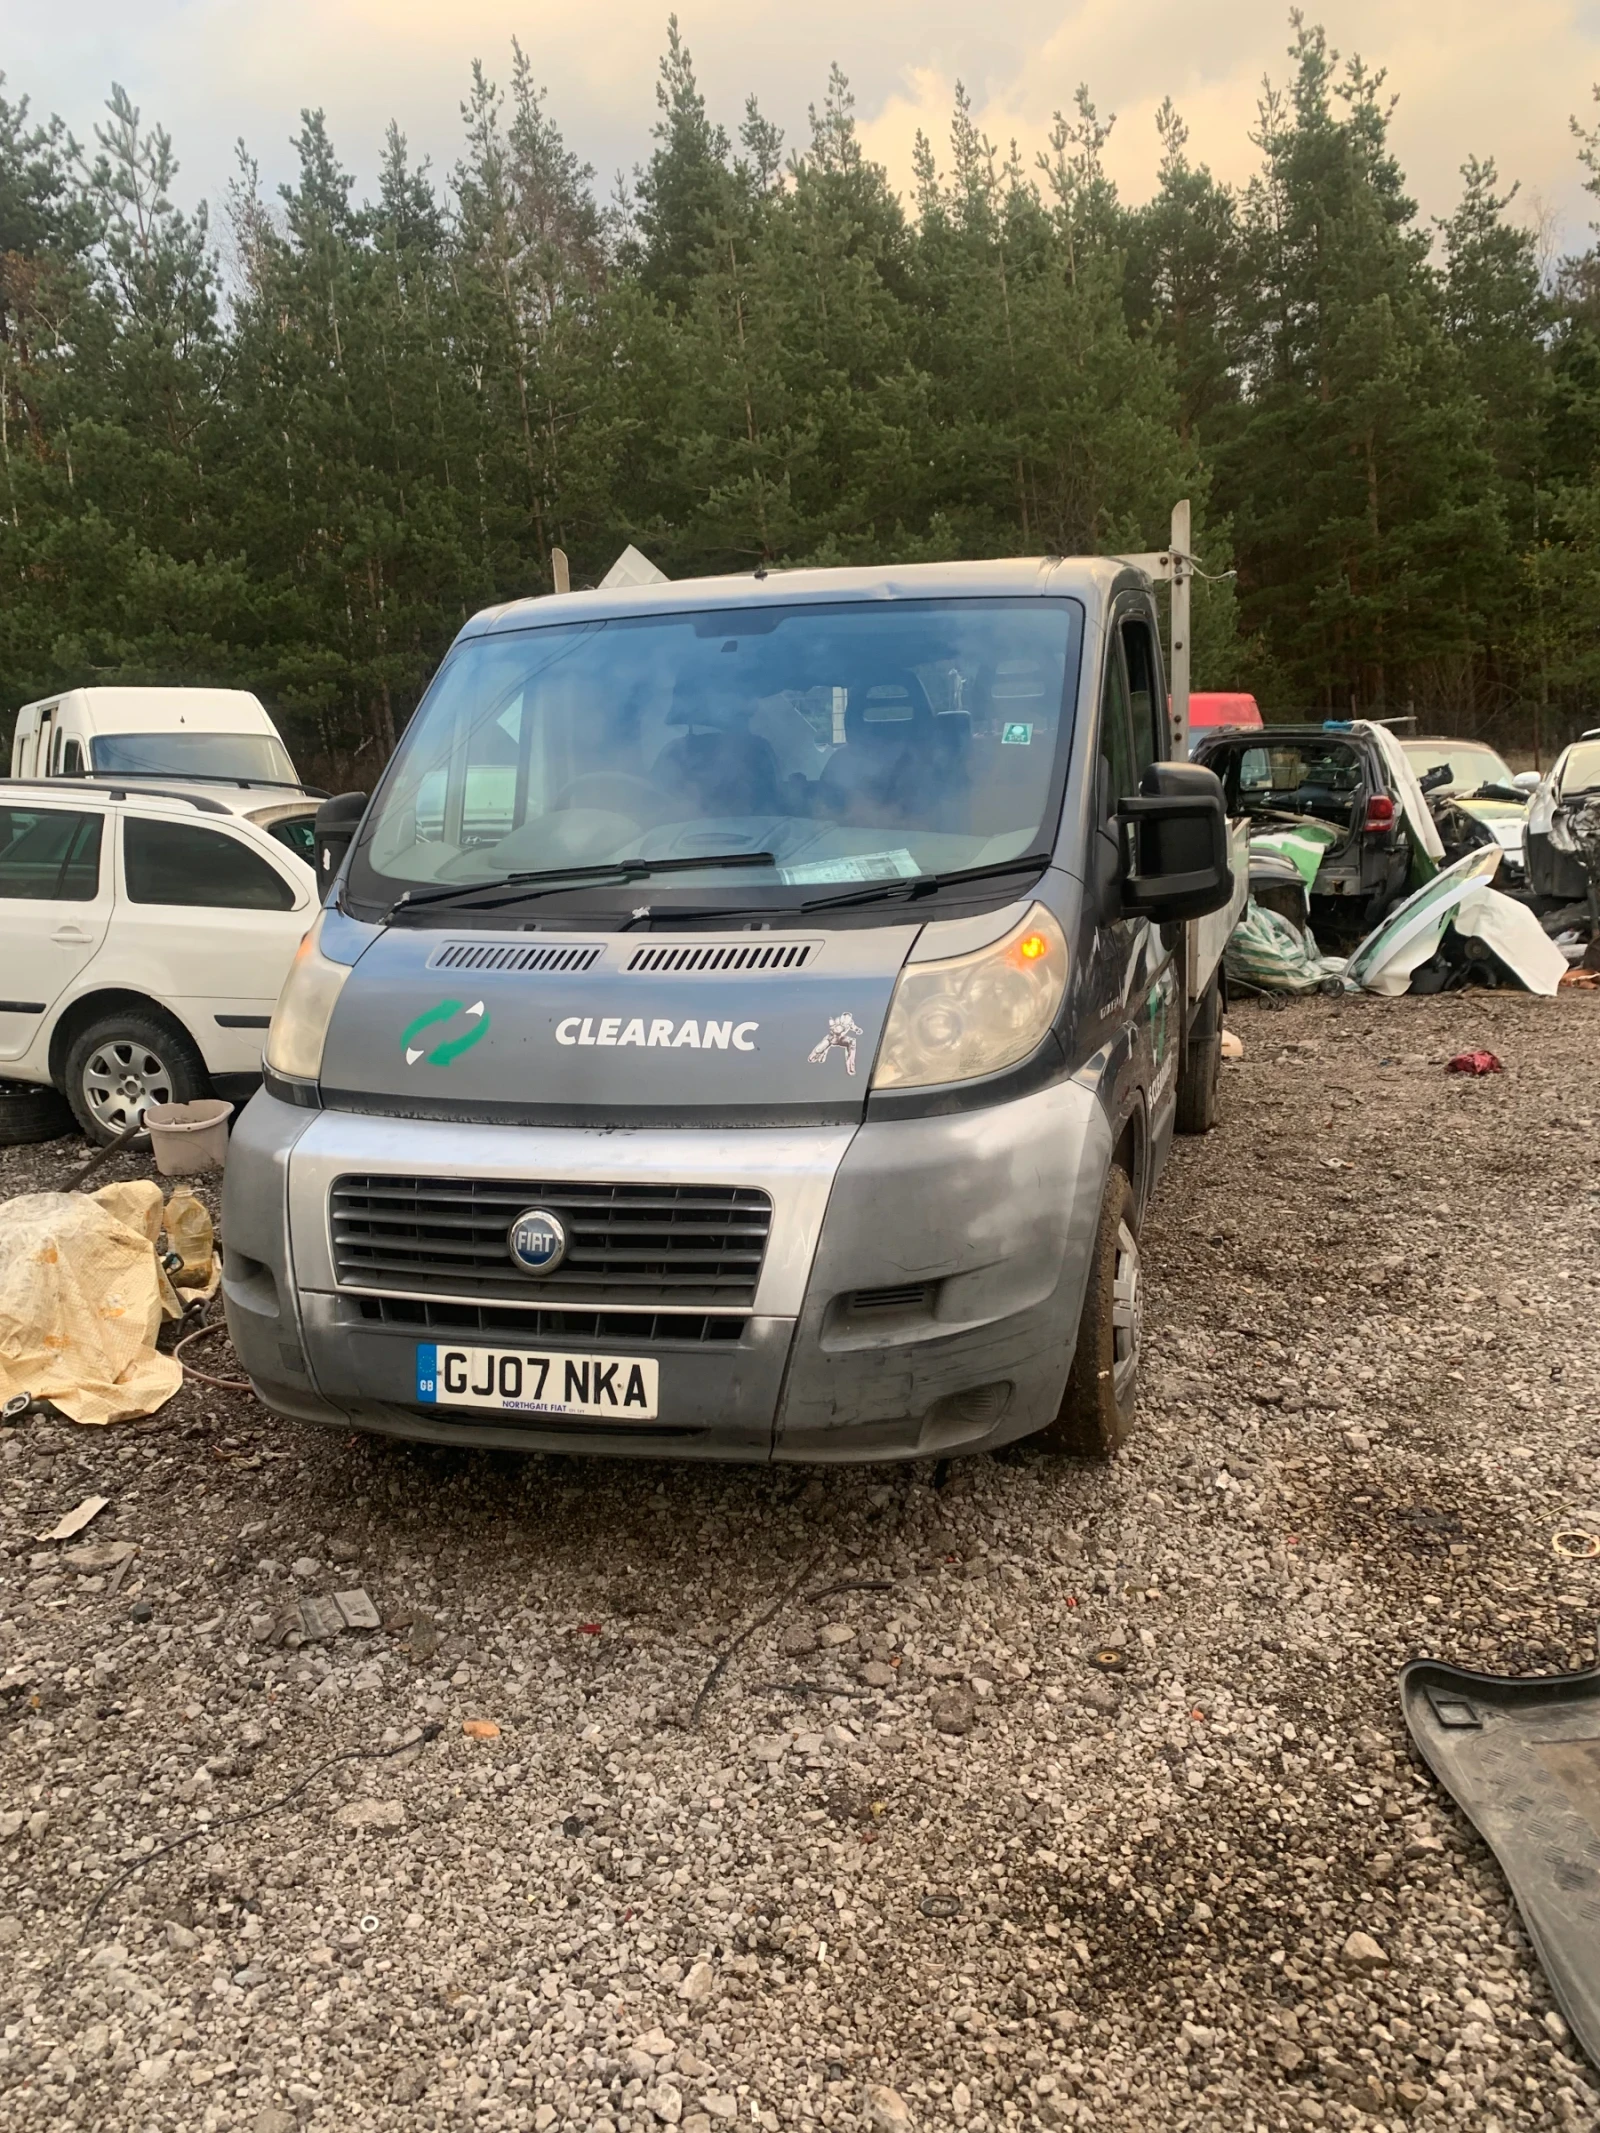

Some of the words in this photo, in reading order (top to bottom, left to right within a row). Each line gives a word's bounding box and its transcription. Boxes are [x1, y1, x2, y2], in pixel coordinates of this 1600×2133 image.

[555, 1017, 760, 1051] CLEARANC
[517, 1231, 554, 1253] FIAT
[420, 1379, 434, 1391] GB
[444, 1352, 551, 1401] GJ07
[564, 1359, 648, 1408] NKA
[502, 1400, 548, 1411] NORTHGATE
[550, 1404, 567, 1412] FIAT
